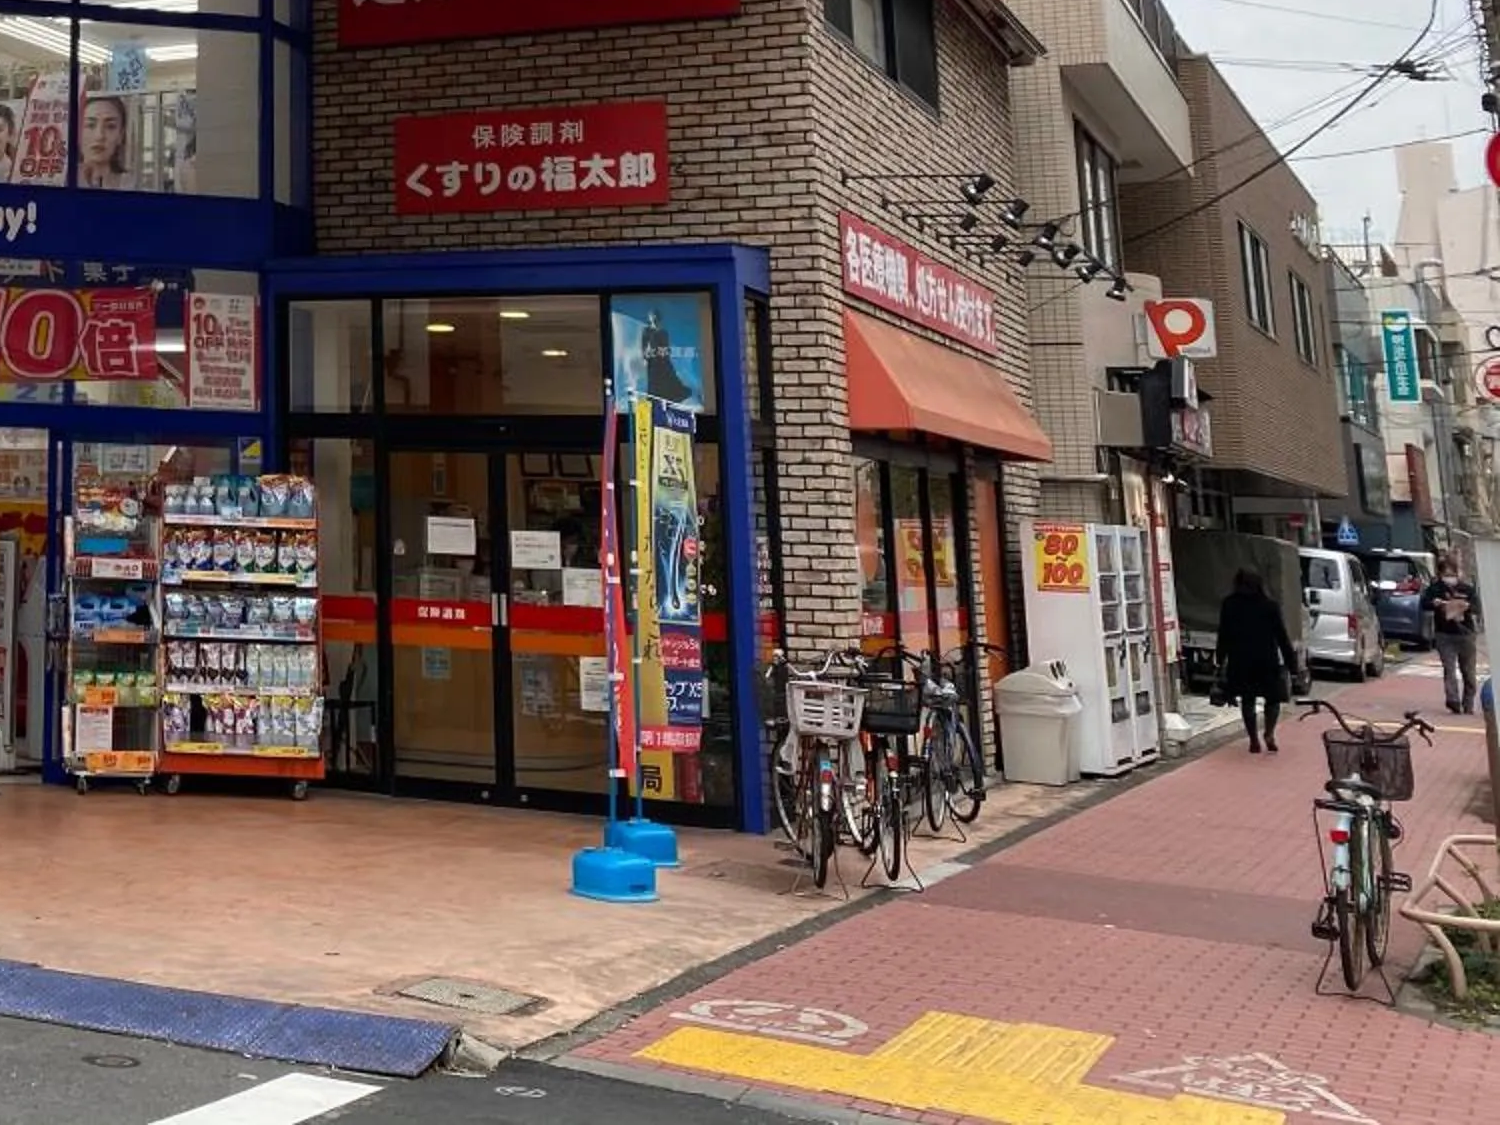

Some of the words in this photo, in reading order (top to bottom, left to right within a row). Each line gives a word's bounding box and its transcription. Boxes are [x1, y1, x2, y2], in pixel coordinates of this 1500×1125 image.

[471, 119, 585, 149] 保険調剤
[19, 157, 63, 177] OFF
[405, 152, 657, 198] くすりの福太郎
[1043, 534, 1079, 557] 80
[1042, 562, 1085, 585] 100
